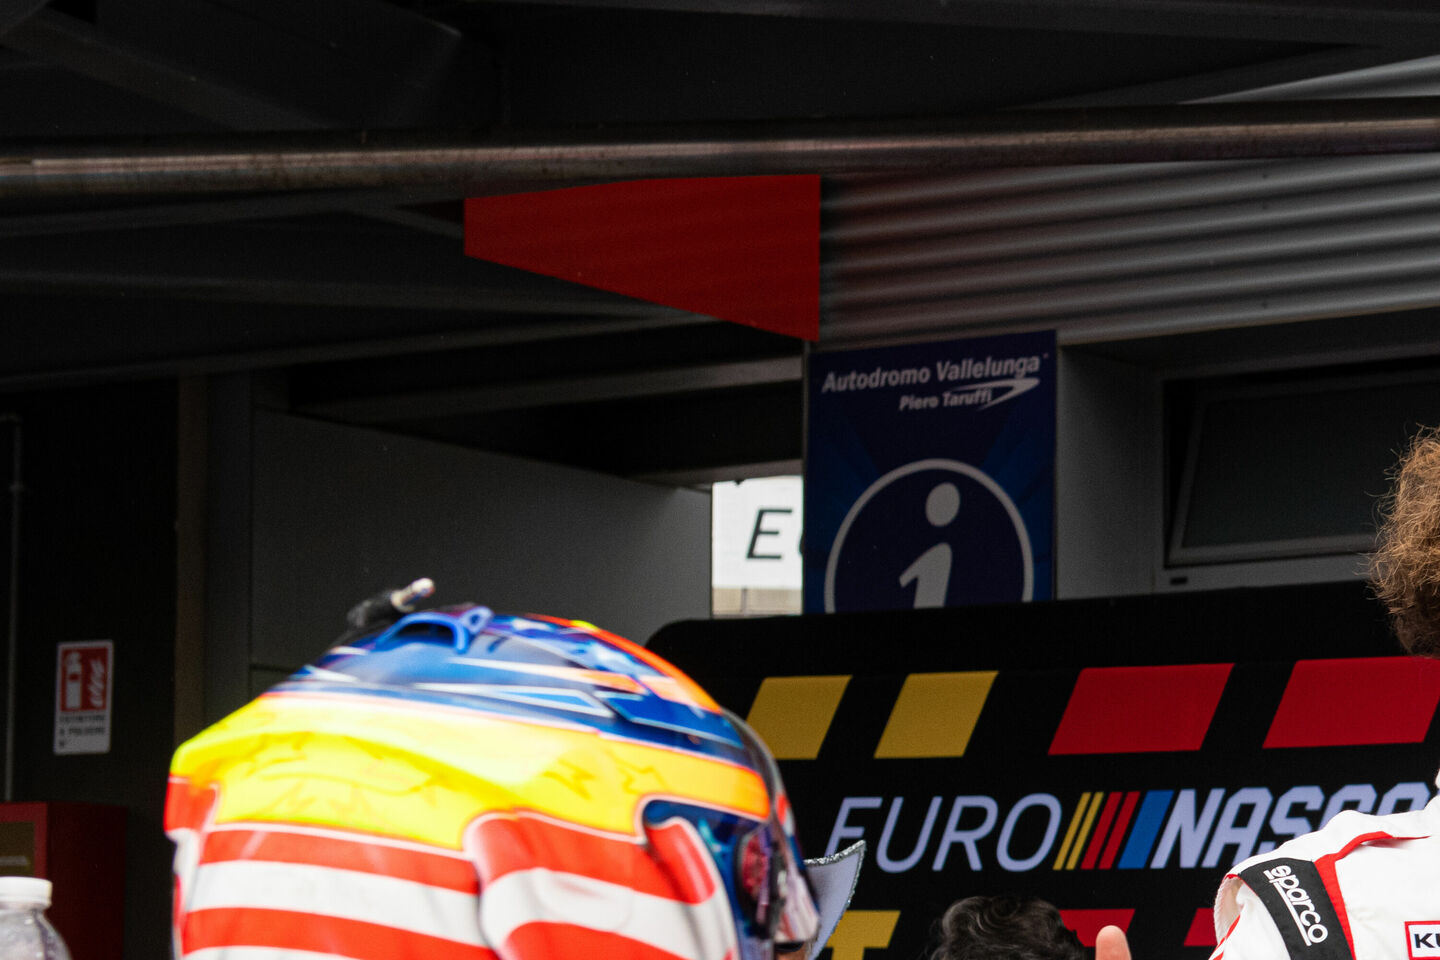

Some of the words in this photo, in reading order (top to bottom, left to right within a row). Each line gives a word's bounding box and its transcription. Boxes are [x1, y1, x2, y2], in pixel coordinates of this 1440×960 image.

[821, 366, 931, 393] Autodromo
[936, 356, 1041, 382] Vallelunga
[899, 394, 938, 411] Piero
[941, 388, 993, 408] Taruffi
[824, 793, 1062, 873] EURO
[1150, 782, 1432, 869] NASC
[1263, 865, 1328, 947] sparco
